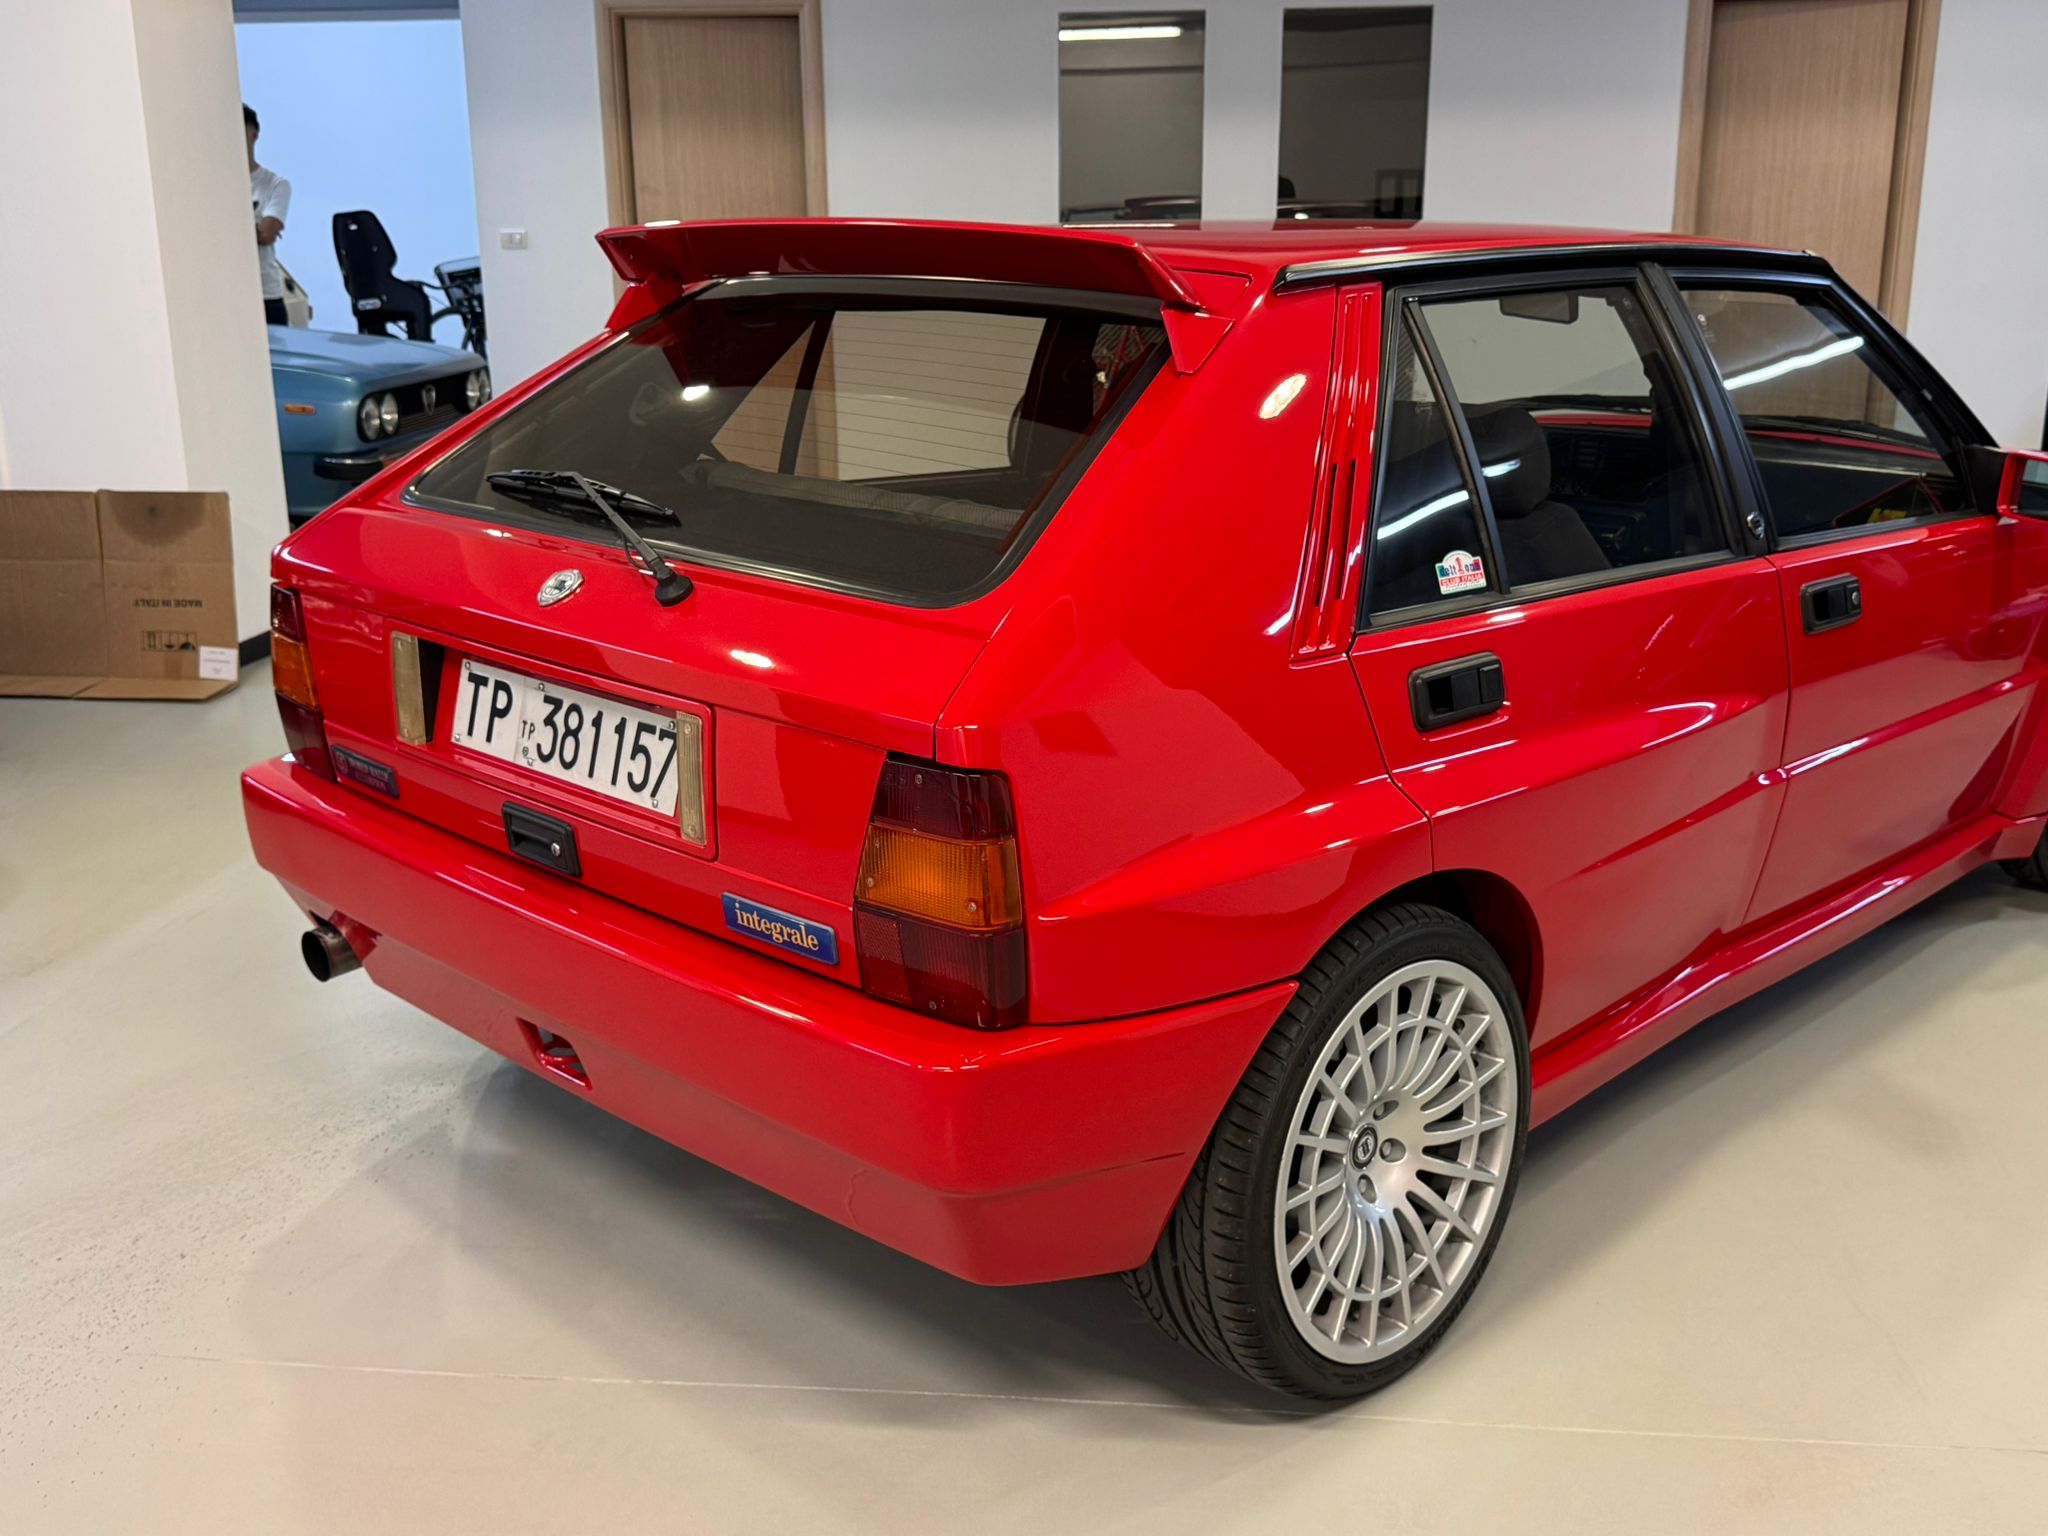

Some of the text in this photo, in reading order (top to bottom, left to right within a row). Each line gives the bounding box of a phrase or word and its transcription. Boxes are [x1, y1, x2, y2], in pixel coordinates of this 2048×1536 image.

[134, 598, 203, 608] MADE IN ITALY
[467, 672, 678, 798] TP 381157
[521, 720, 536, 741] TP
[735, 902, 819, 951] integrale
